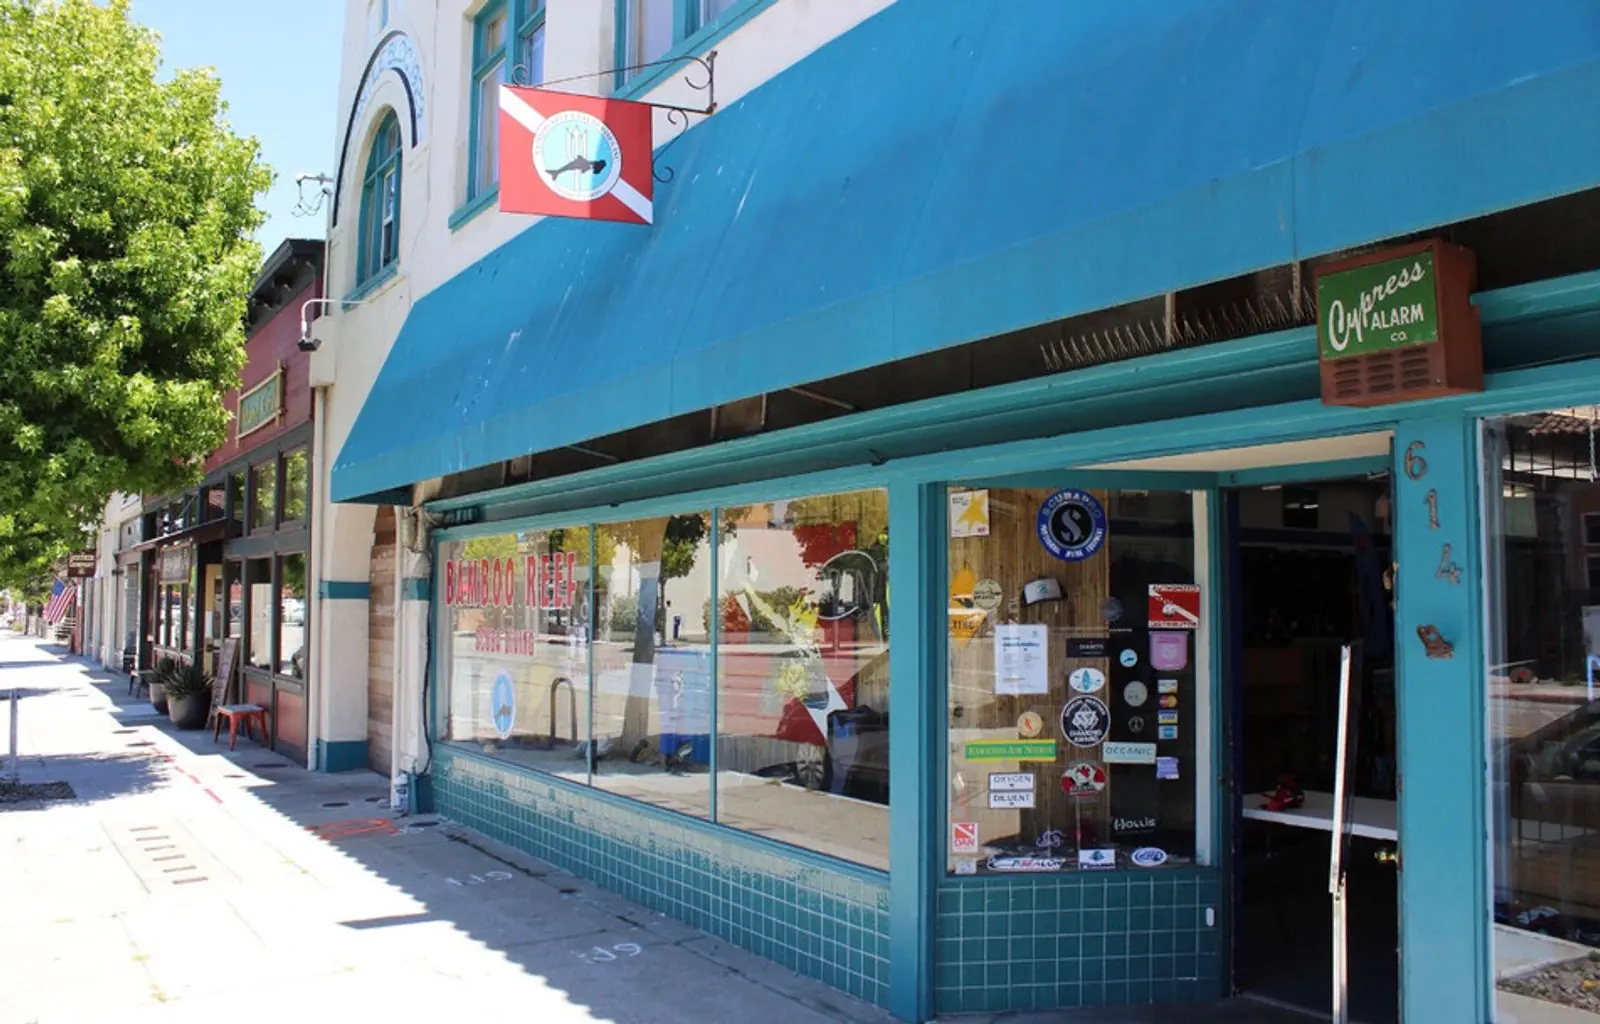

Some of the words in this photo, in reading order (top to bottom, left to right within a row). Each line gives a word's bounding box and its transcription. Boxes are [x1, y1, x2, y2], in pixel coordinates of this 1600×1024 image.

[1328, 261, 1426, 352] Cypress
[1370, 302, 1425, 331] ALARM
[445, 557, 516, 608] BAMBOO
[525, 551, 577, 609] REEF
[993, 775, 1032, 784] OXYGEN
[993, 794, 1030, 803] DILUENT
